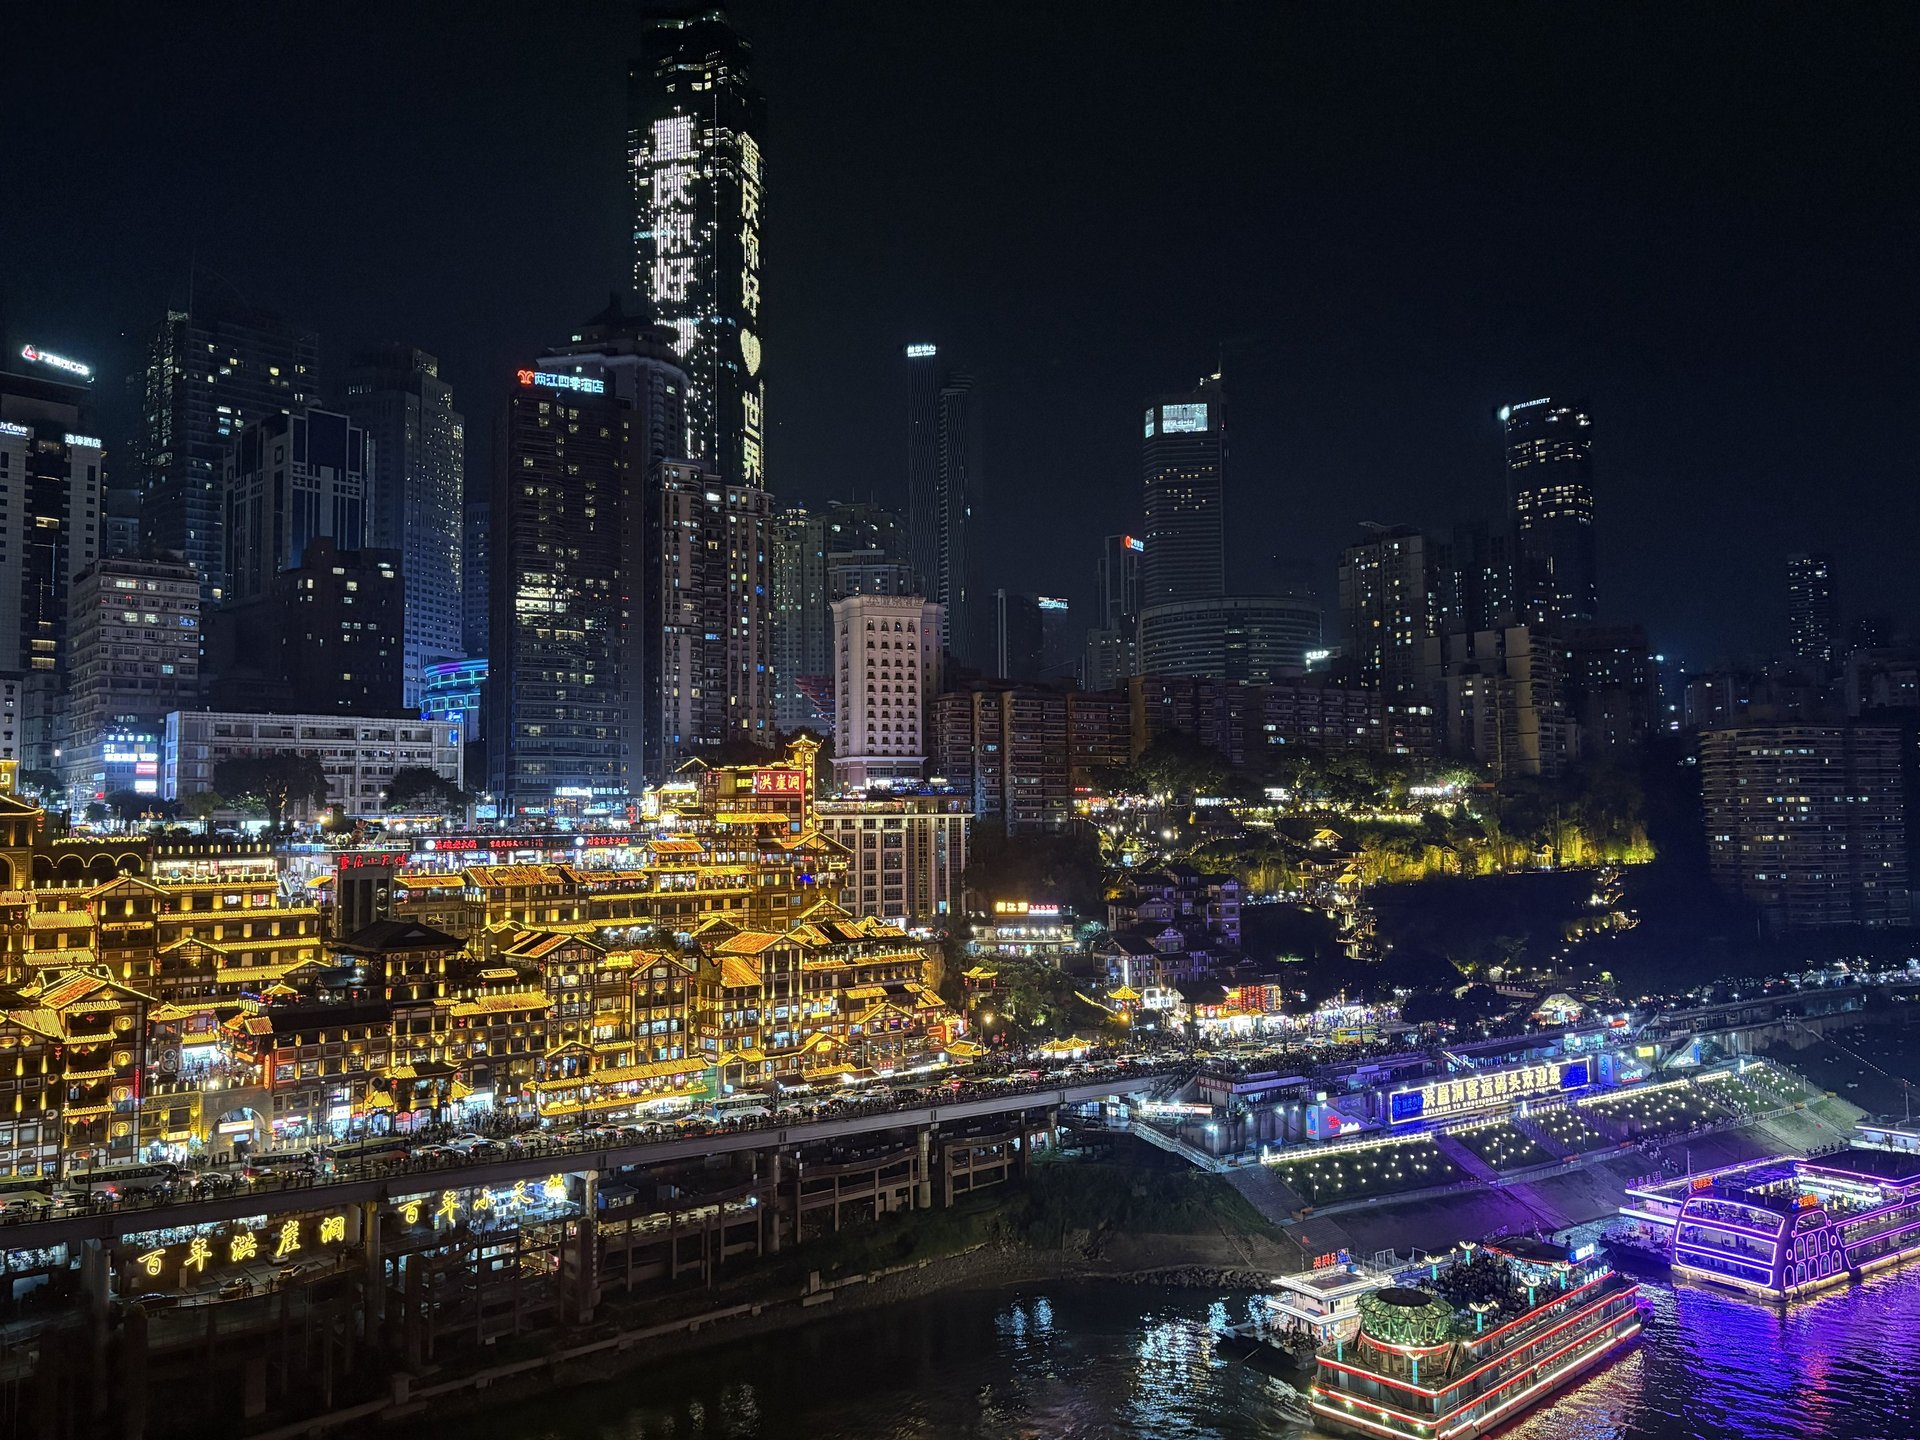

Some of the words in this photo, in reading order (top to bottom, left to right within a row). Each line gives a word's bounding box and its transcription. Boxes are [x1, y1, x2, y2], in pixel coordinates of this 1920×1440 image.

[739, 131, 761, 319] 重庆你好
[534, 372, 605, 394] 两江四季酒店
[742, 390, 761, 486] 世界
[759, 773, 801, 792] 洪崖洞
[337, 853, 408, 870] 重庆小天鹅
[400, 1173, 568, 1225] 百年小天鹅
[138, 1216, 346, 1277] 百年洪崖洞
